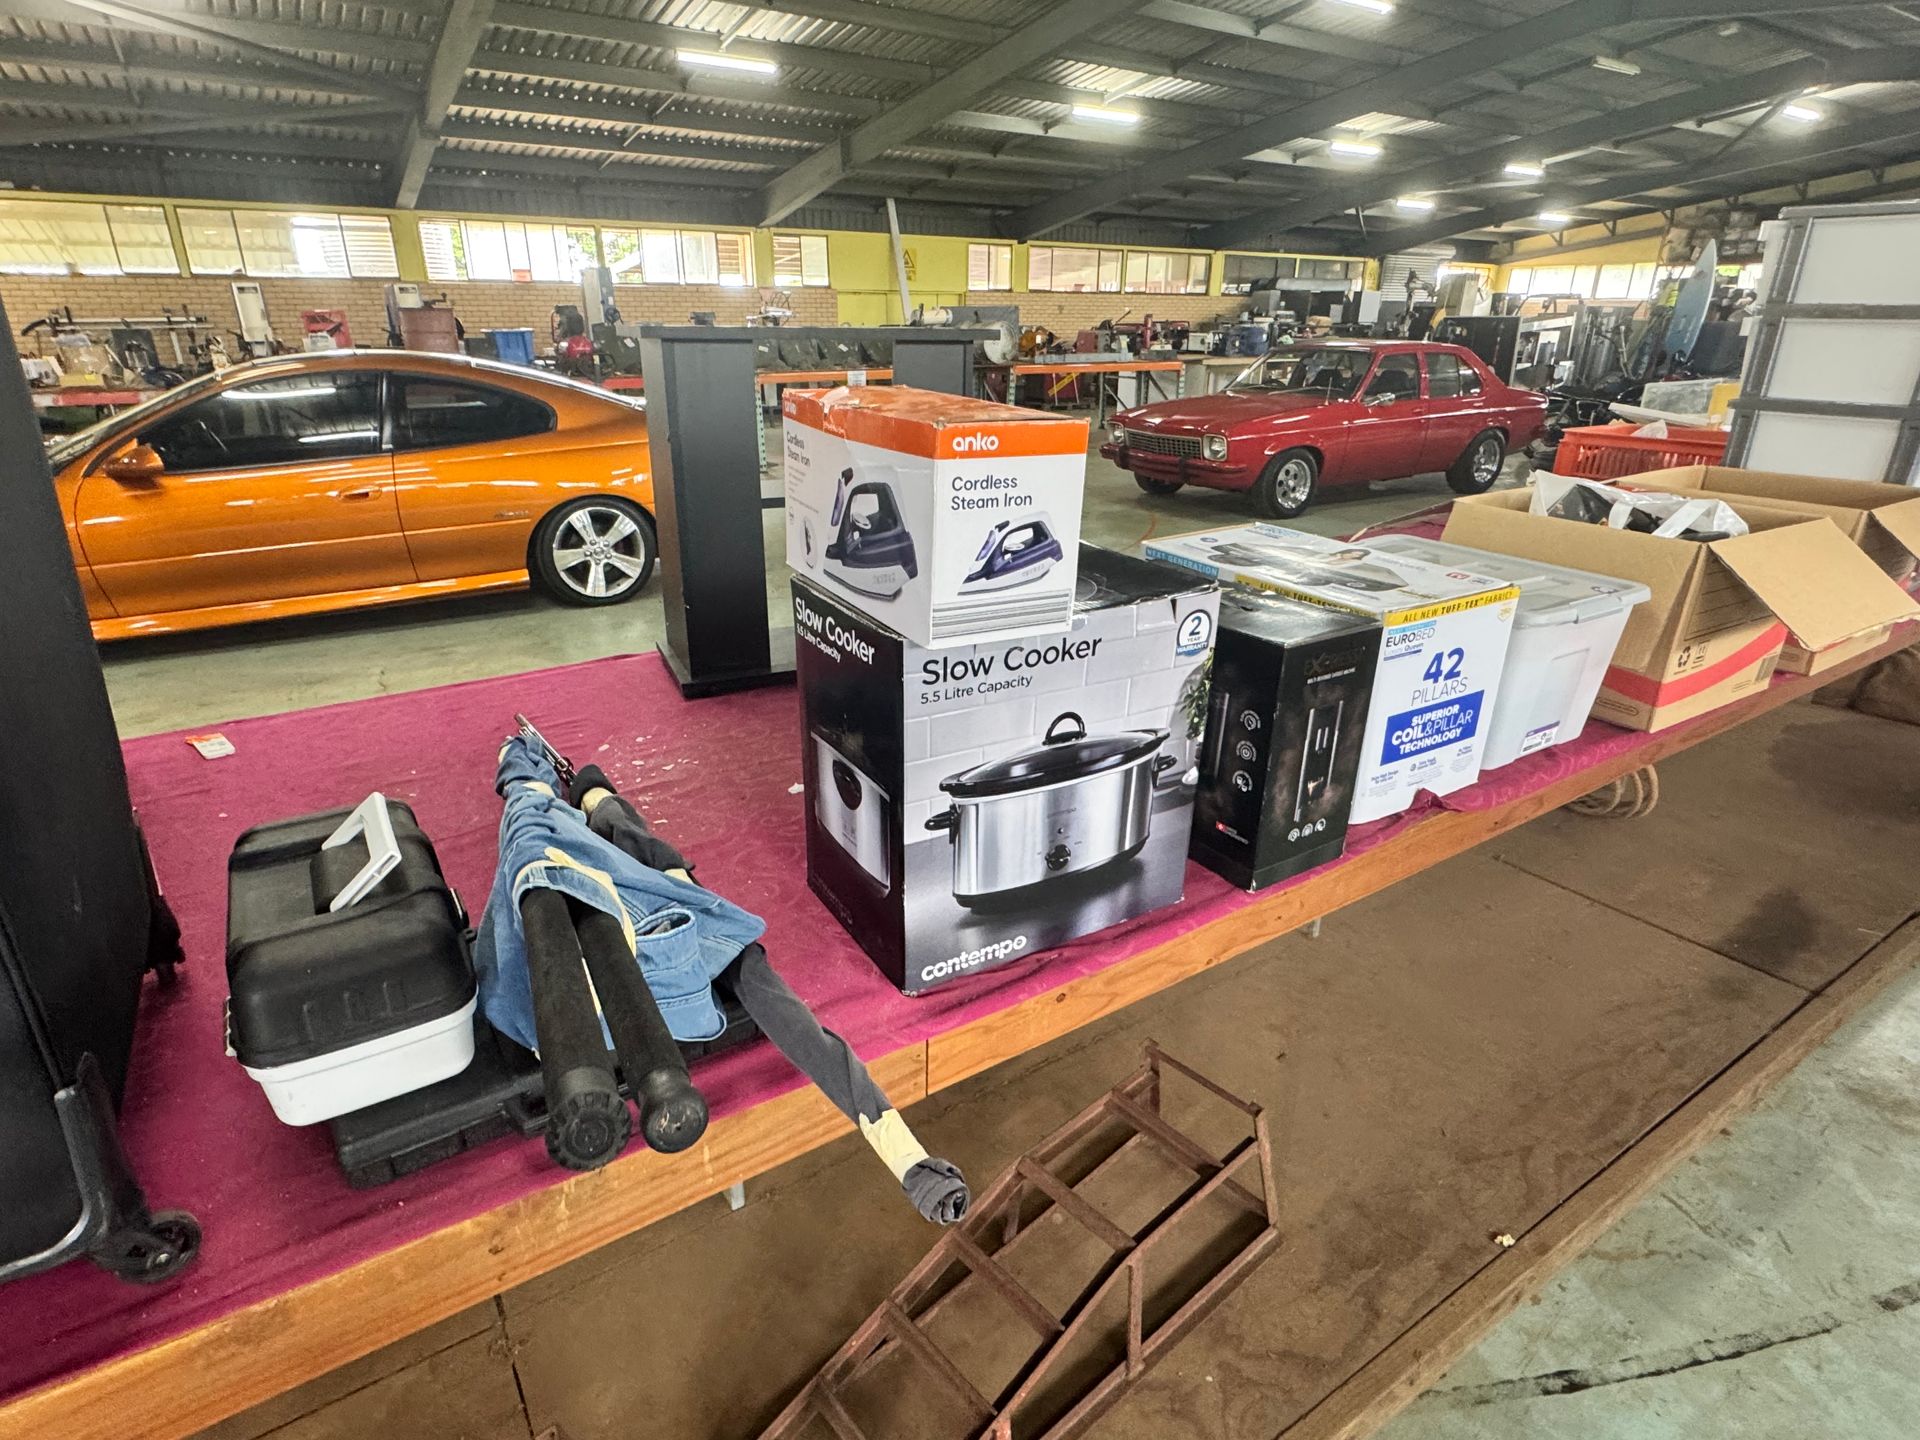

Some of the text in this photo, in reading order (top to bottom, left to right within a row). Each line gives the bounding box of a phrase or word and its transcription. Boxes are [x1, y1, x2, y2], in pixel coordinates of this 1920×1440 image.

[952, 432, 999, 451] anko
[952, 474, 1018, 492] Cordless
[951, 493, 1032, 510] Steam Iron
[1167, 555, 1218, 577] GENERATION
[1189, 615, 1202, 637] 2
[1402, 613, 1418, 623] ALL
[1420, 609, 1440, 621] NEW
[795, 597, 875, 664] Slow Cooker
[1385, 627, 1436, 648] EUROBED
[921, 637, 1102, 686] Slow Cooker
[1422, 647, 1465, 684] 42
[920, 675, 1033, 705] 5.5 Litre Capacity
[1411, 676, 1468, 707] PILLARS
[1411, 704, 1460, 727] SUPERIOR
[1399, 727, 1463, 755] TECHNOLOGY
[921, 935, 1027, 981] contempo
